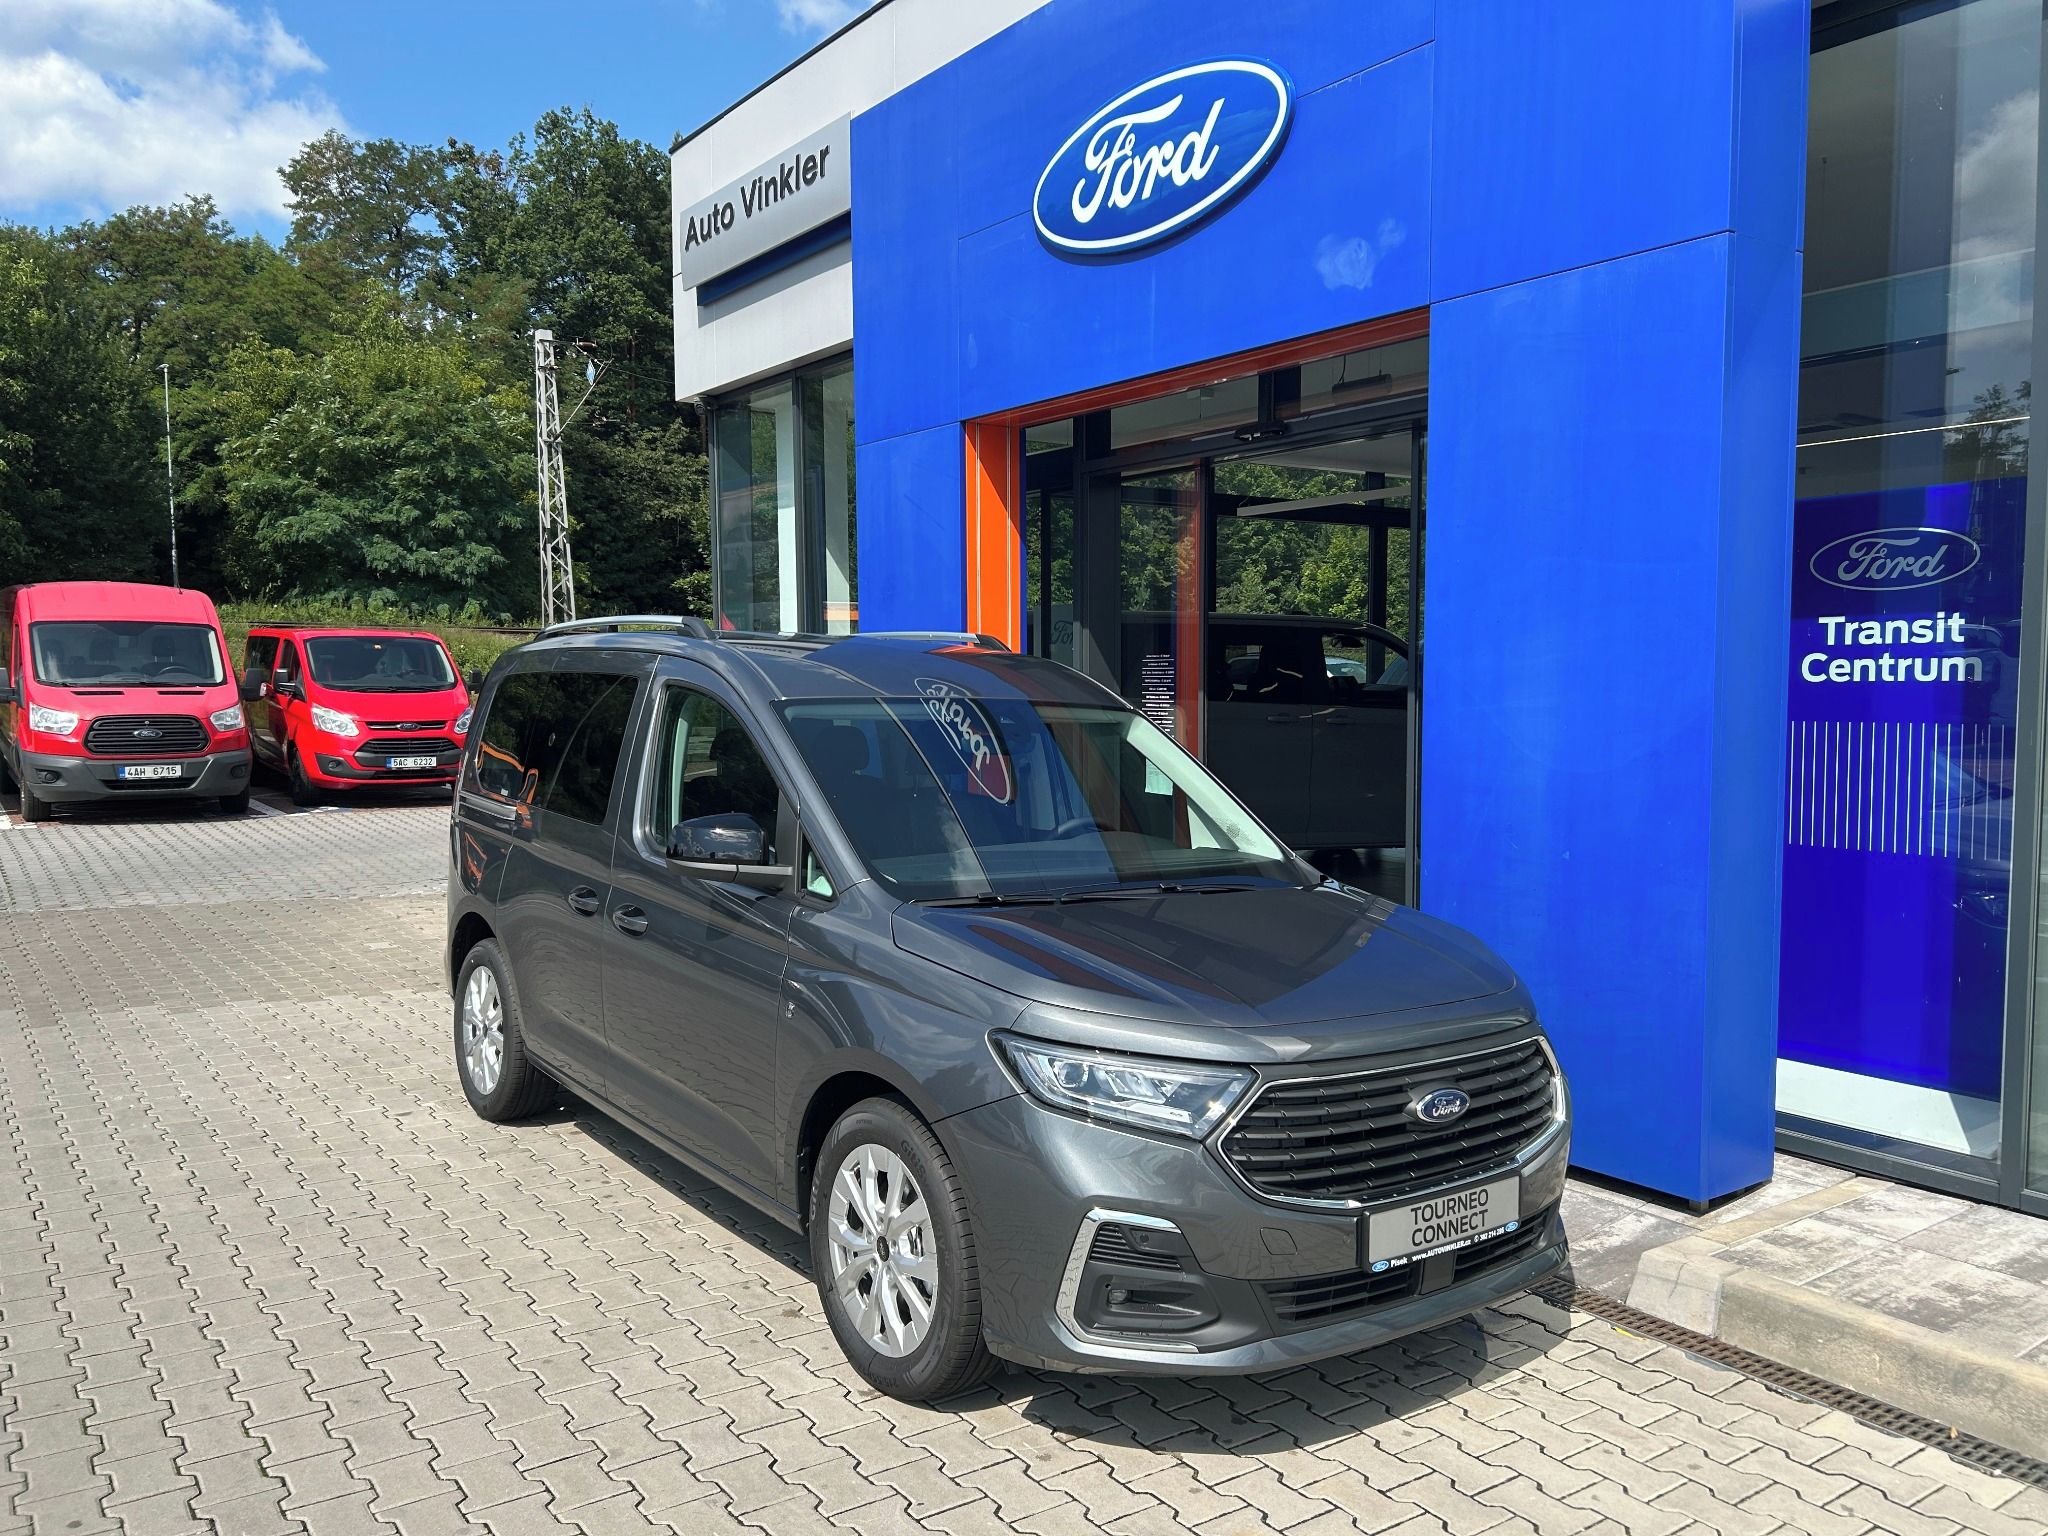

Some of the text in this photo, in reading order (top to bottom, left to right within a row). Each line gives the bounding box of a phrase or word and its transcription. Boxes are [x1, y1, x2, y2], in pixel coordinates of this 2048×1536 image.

[1071, 94, 1225, 223] Ford
[685, 145, 830, 252] Auto Vinkler
[1838, 537, 1948, 581] Ford
[1818, 611, 1965, 646] Transit
[1801, 652, 1983, 683] Centrum
[127, 766, 177, 777] 4AH 6715
[393, 757, 433, 767] 5AC 6232
[1432, 1096, 1461, 1117] Ford
[1410, 1189, 1489, 1225] TOURNEO
[1411, 1209, 1489, 1247] CONNECT
